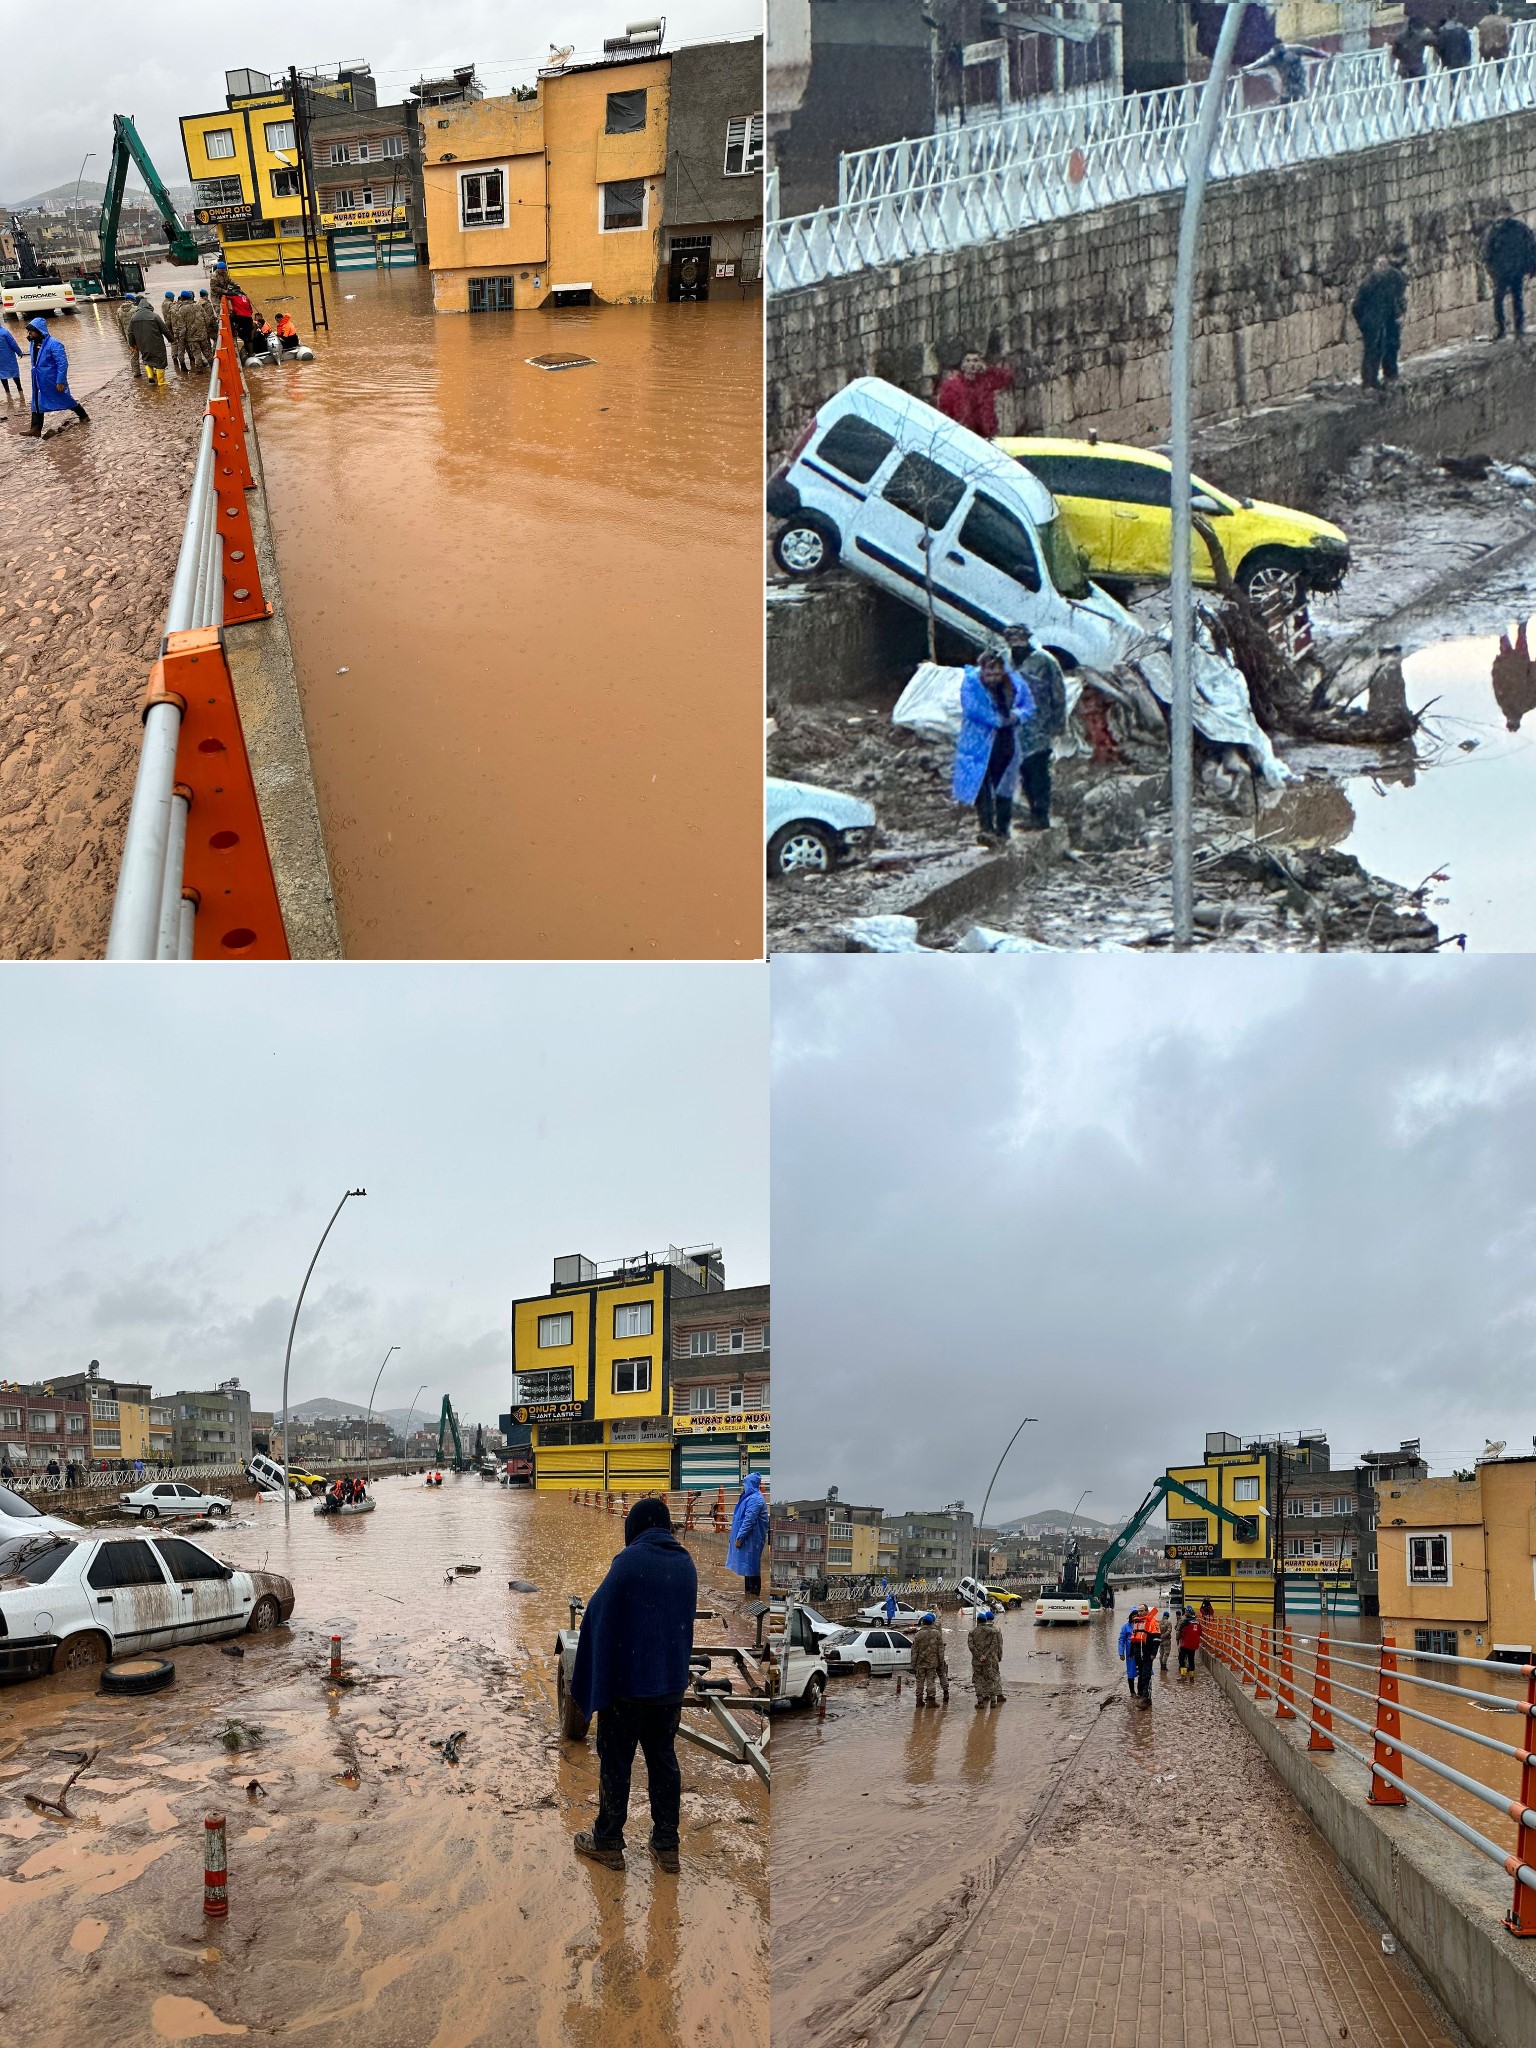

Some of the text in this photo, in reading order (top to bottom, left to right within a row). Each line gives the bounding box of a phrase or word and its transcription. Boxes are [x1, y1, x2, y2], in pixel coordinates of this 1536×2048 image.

[208, 205, 252, 216] ONUR OTO
[333, 209, 392, 221] MURAT OTO MUSIC
[20, 292, 57, 300] HIDROMEK
[528, 1402, 582, 1414] ONUR OTO
[690, 1413, 770, 1425] MURAT OTO MUSI
